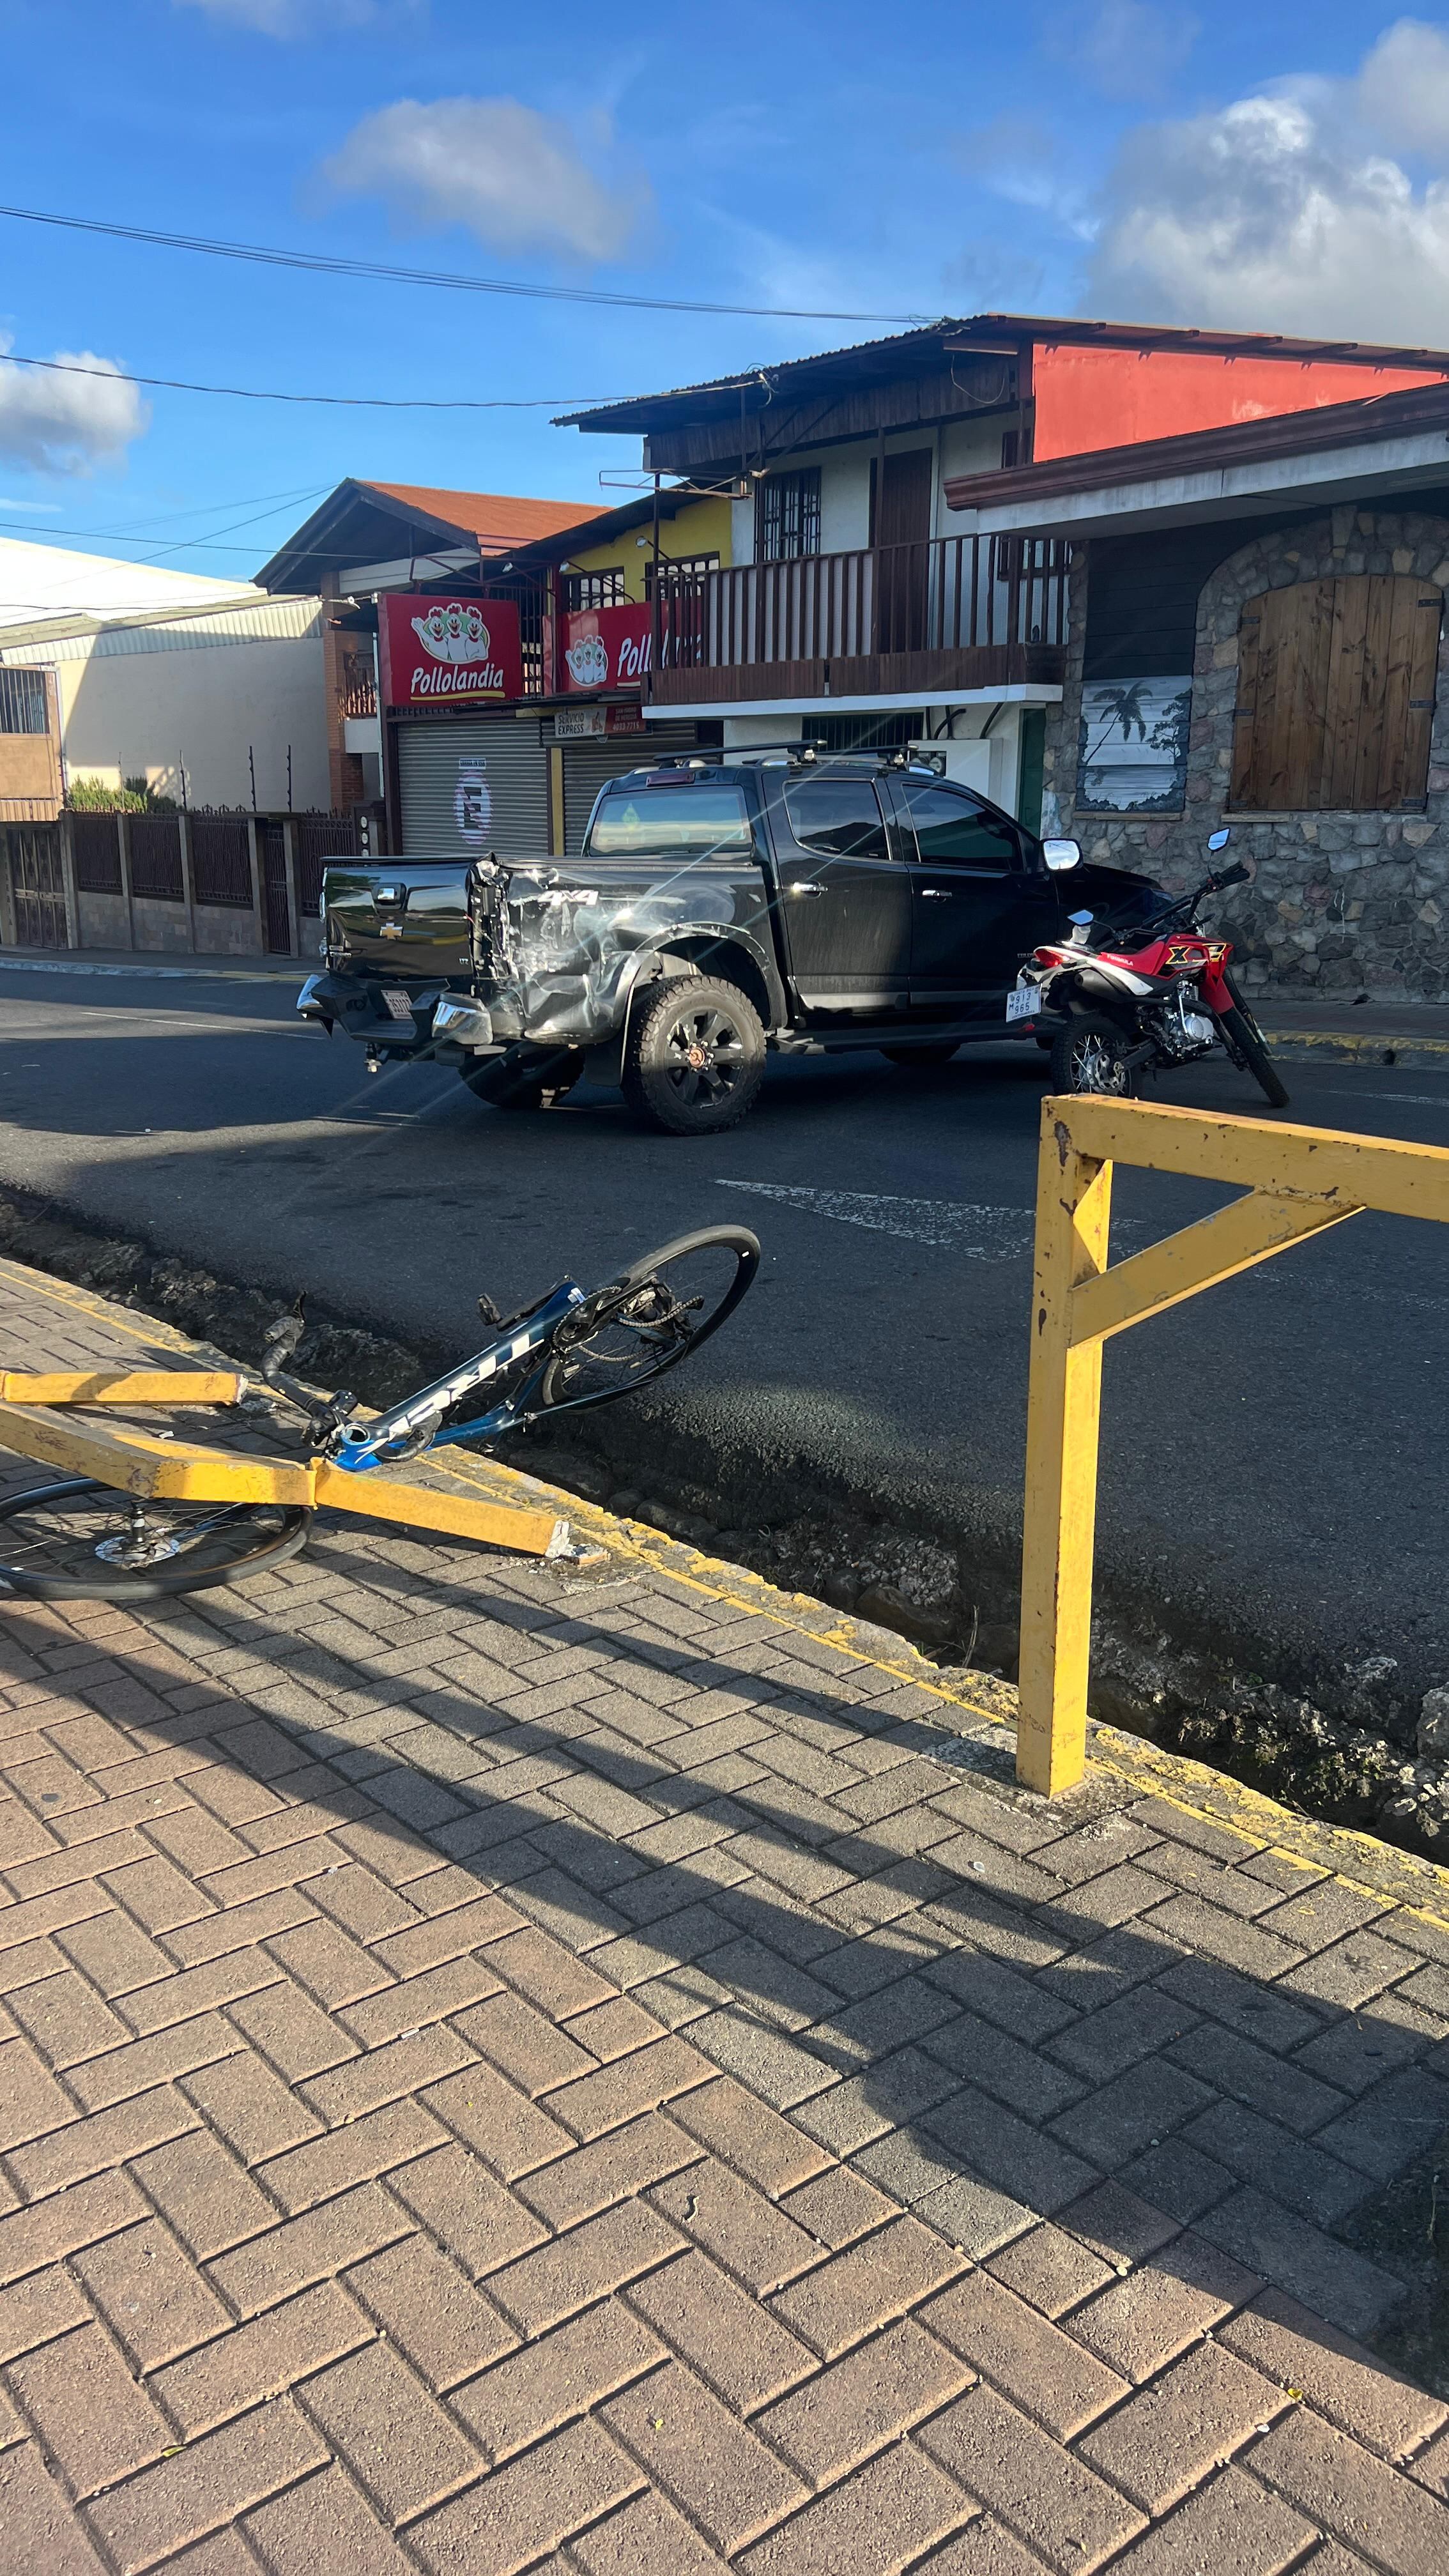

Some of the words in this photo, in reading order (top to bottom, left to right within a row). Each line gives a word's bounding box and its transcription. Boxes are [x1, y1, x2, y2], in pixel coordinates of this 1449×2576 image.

[411, 662, 504, 694] Pollolandia
[558, 712, 585, 724] SERVICIO
[558, 723, 584, 735] EXPRESS
[1015, 992, 1031, 1004] 913
[1009, 1002, 1014, 1011] M
[1015, 1001, 1030, 1014] 965
[355, 1333, 544, 1464] TREK
